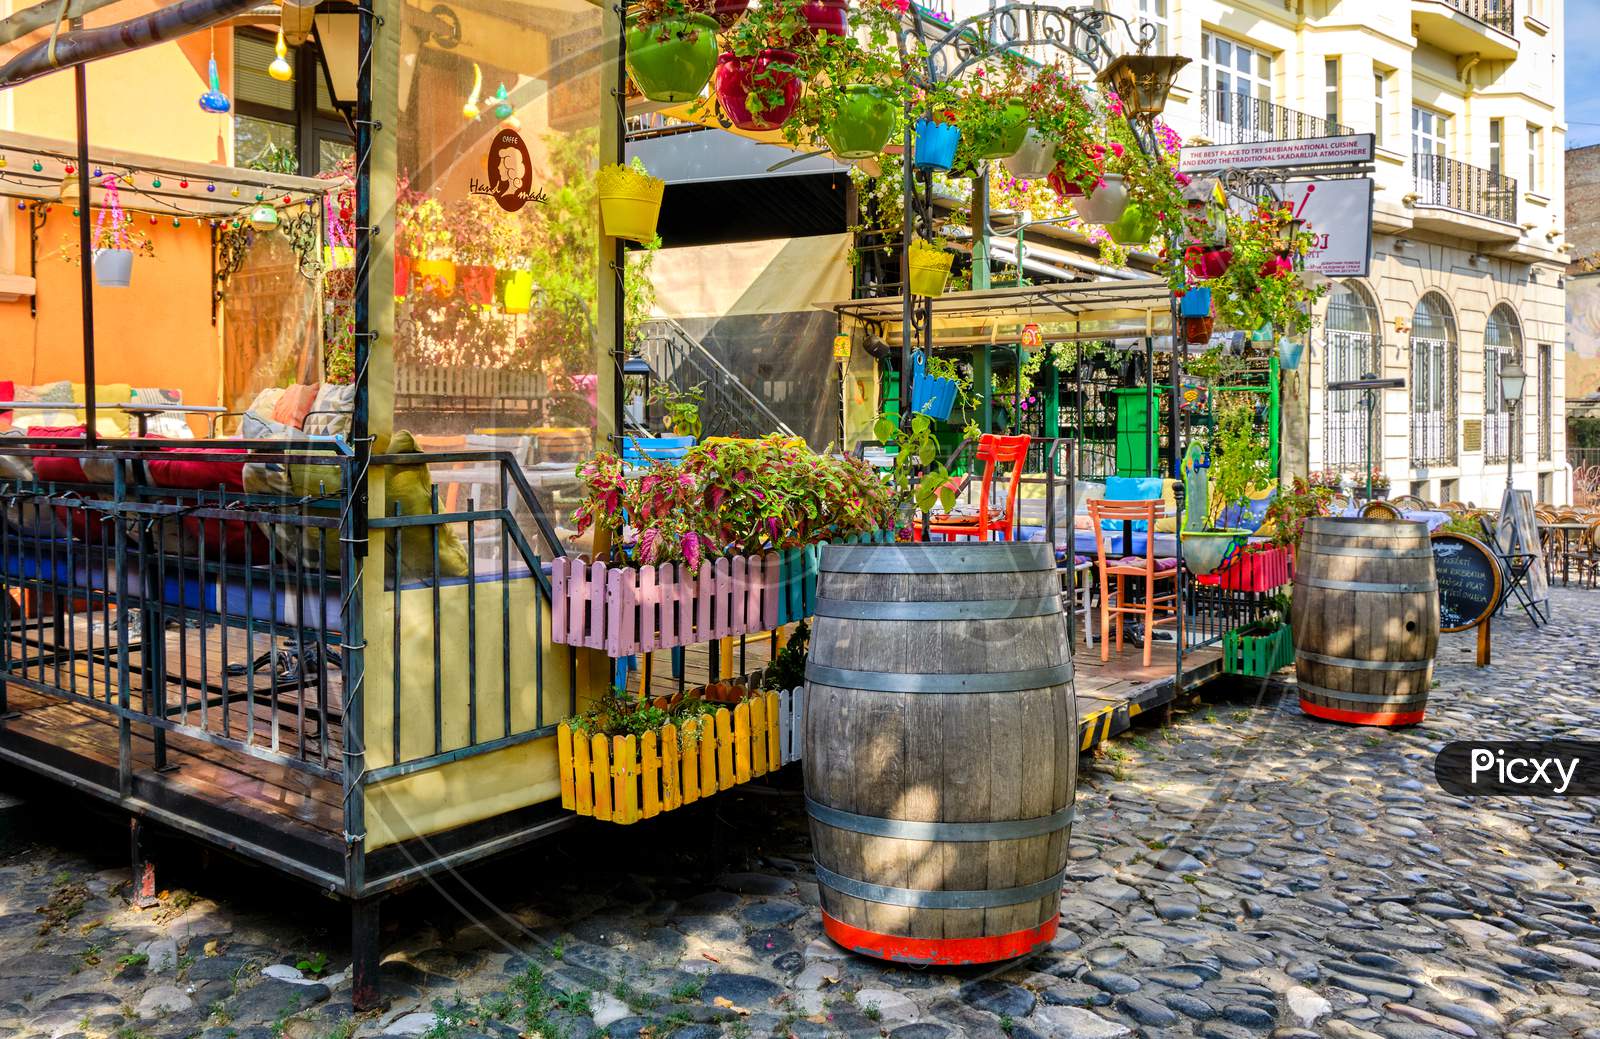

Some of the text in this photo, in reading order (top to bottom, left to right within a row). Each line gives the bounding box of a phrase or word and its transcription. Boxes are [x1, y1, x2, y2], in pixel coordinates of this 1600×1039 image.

[502, 135, 518, 144] CAFFE
[1197, 158, 1217, 166] ENJOY
[1231, 154, 1275, 163] TRADITIONAL
[1277, 152, 1318, 161] SKADARLIJA
[1319, 148, 1367, 157] ATMOSPHERE
[1203, 150, 1218, 158] BEST
[1219, 149, 1240, 157] PLACE
[1241, 148, 1250, 156] TO
[1251, 147, 1263, 155] TRY
[1264, 145, 1293, 154] SERBIAN
[1294, 143, 1328, 152] NATIONAL
[1330, 140, 1358, 149] CUISINE
[469, 178, 549, 202] Hand made
